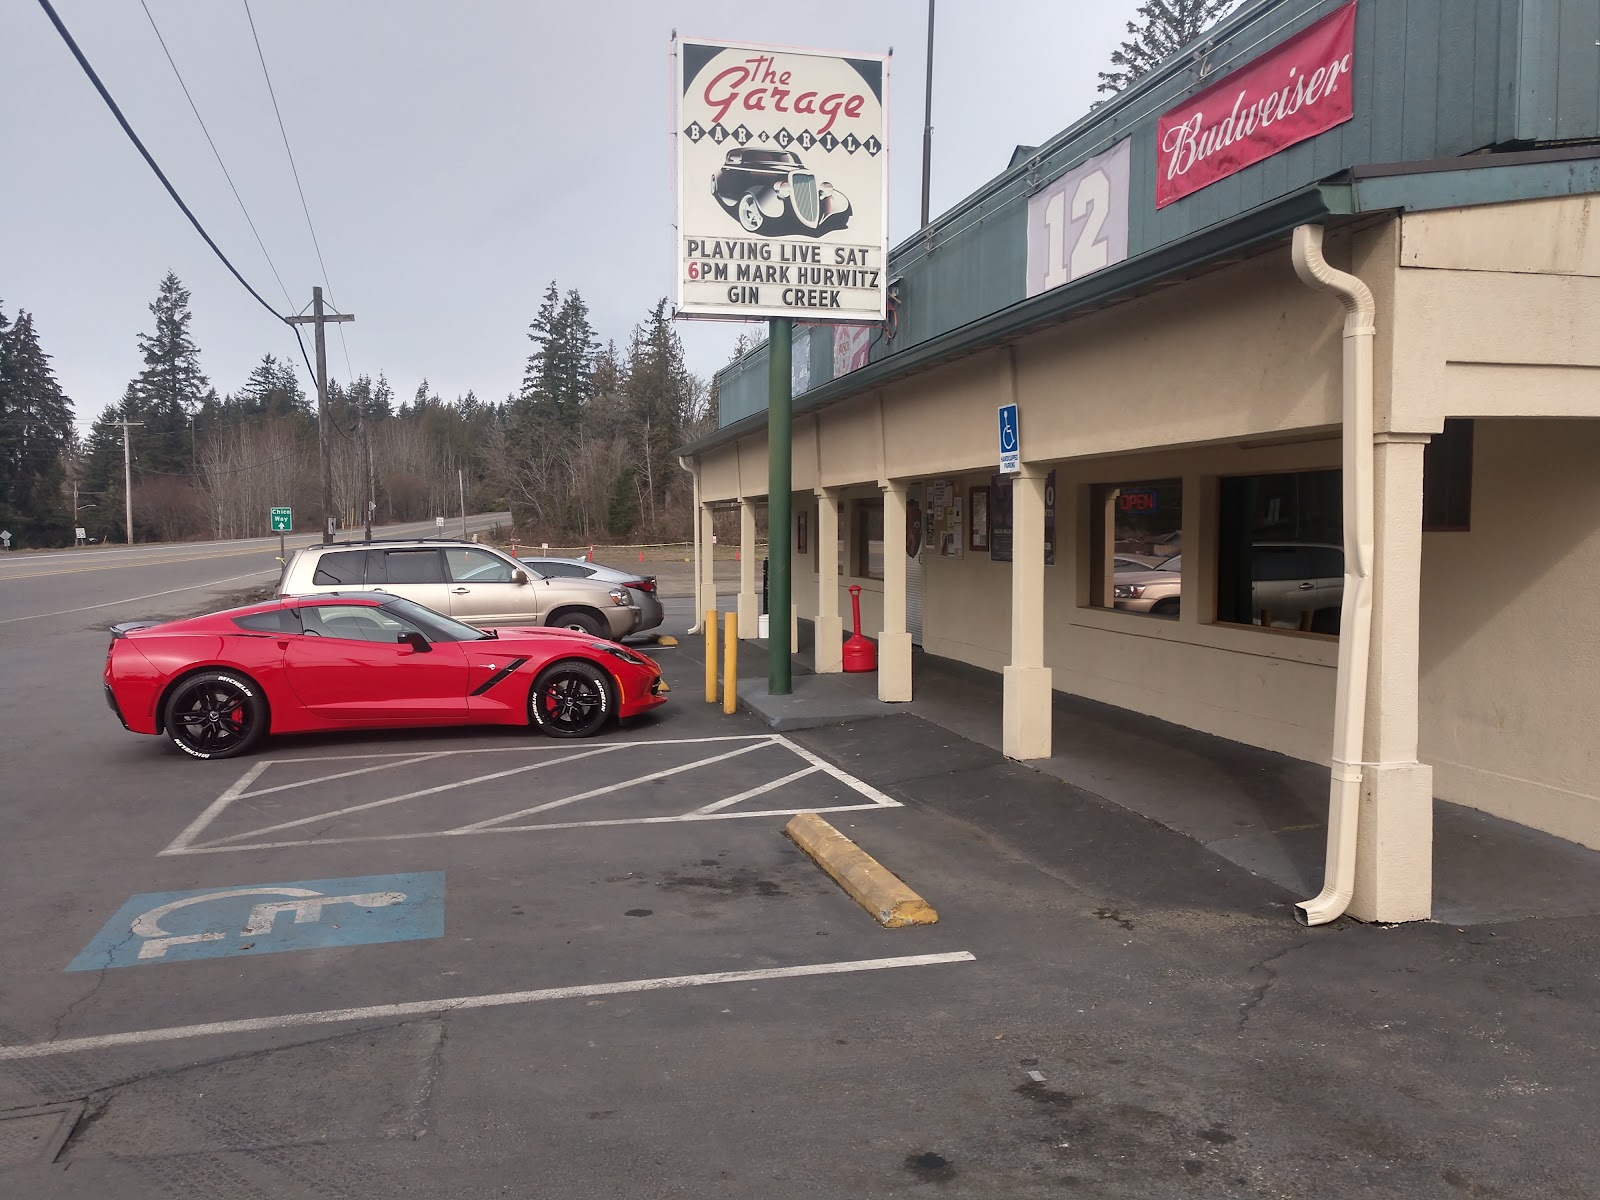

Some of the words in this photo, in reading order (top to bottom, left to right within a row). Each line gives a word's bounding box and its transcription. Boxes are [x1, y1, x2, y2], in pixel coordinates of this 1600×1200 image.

[745, 55, 792, 86] The
[703, 65, 865, 135] Garage
[1162, 52, 1350, 181] Budweiser
[690, 122, 747, 143] BAR
[779, 132, 877, 154] GRILL
[1043, 168, 1111, 292] 12
[687, 239, 772, 262] PLAYING
[780, 244, 821, 264] LIVE
[835, 248, 869, 266] SAT
[688, 262, 728, 281] 6PM
[736, 263, 790, 283] MARK
[797, 267, 880, 288] HURWITZ
[727, 285, 760, 305] GIN
[781, 287, 841, 308] CREEK
[1119, 494, 1153, 510] OPEN
[217, 675, 253, 698] MICHELIN
[594, 679, 607, 713] MICHELIN
[532, 691, 544, 725] MICHELIN
[173, 738, 211, 759] MICHELIN
